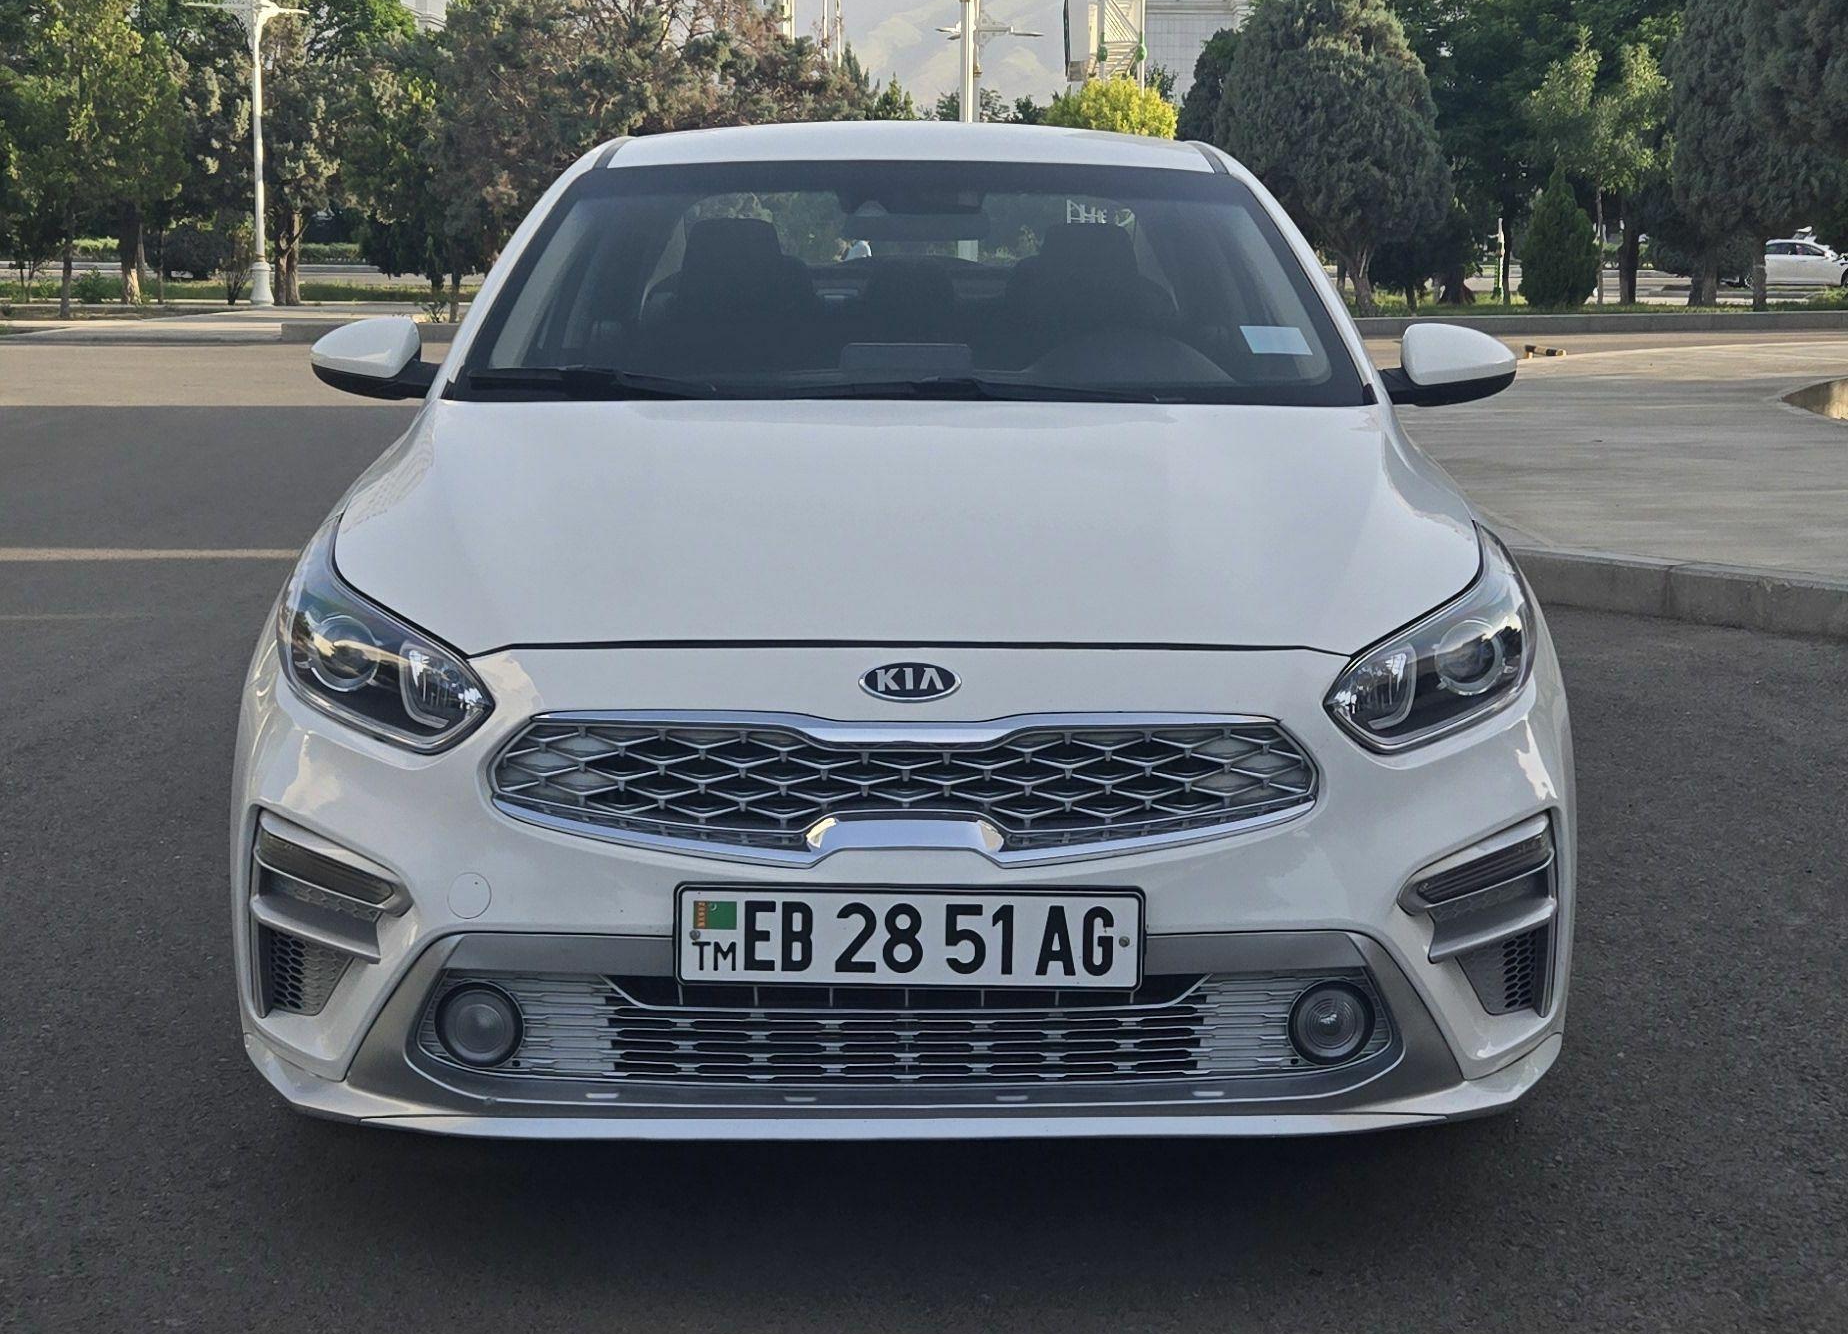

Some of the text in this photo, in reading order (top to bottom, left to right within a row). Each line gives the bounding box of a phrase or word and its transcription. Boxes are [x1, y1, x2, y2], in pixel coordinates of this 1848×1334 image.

[875, 667, 945, 692] KIA
[691, 900, 1116, 977] TM EB 28 51 AG
